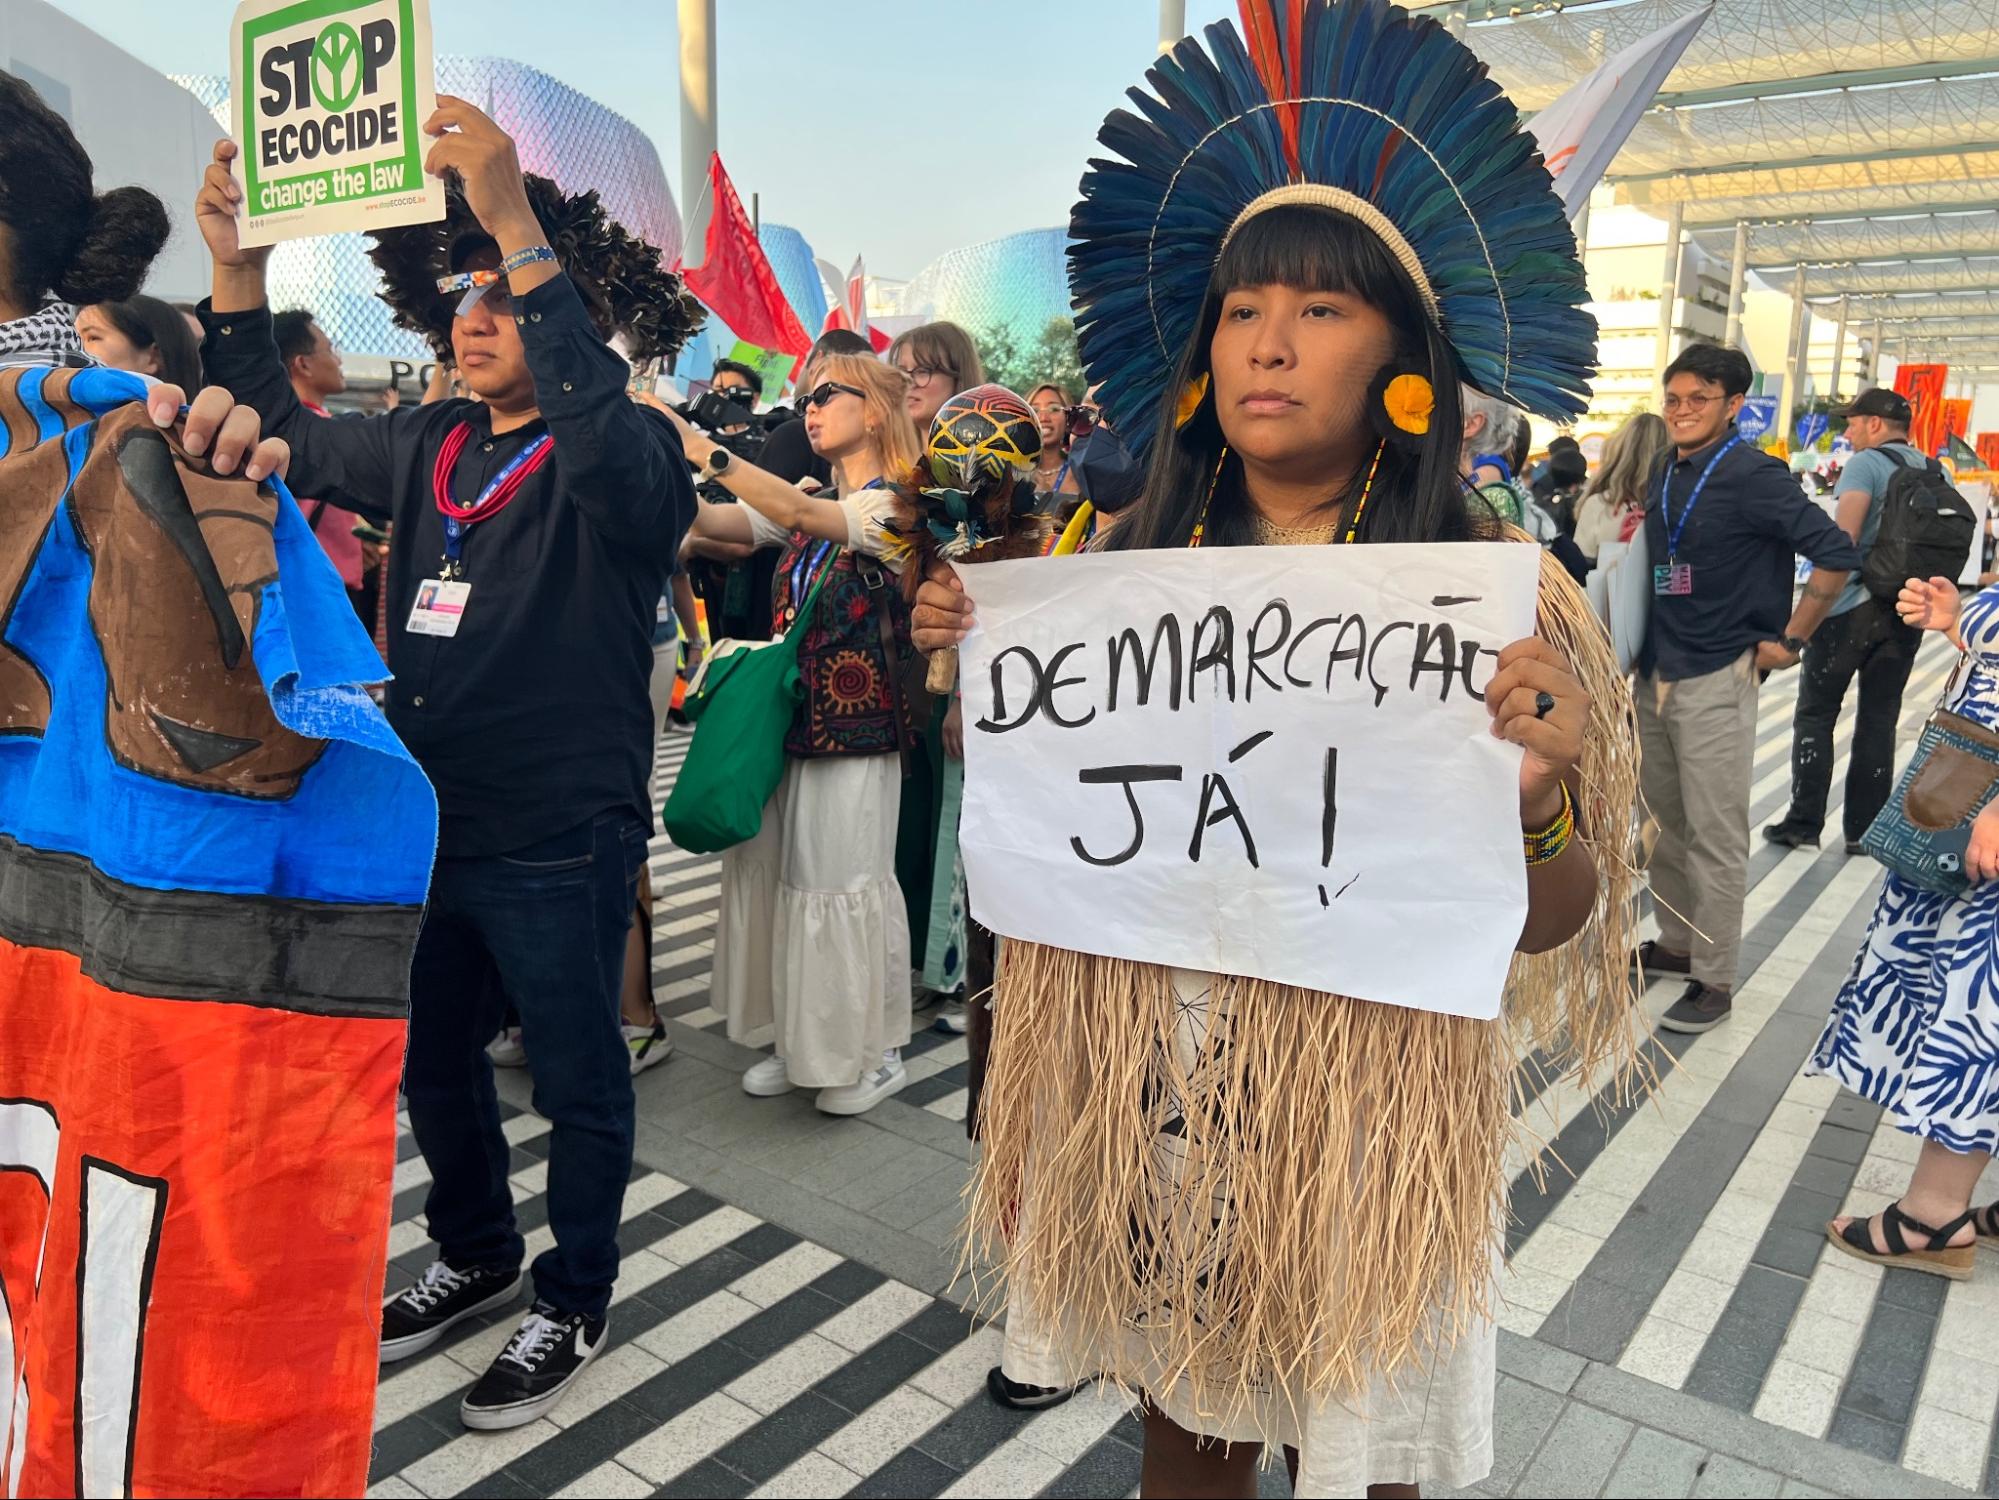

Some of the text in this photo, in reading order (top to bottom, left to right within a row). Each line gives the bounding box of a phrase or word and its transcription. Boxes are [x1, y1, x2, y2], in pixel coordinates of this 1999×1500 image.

[259, 18, 396, 118] STOP
[261, 101, 398, 168] ECOCIDE
[260, 161, 405, 210] change the law
